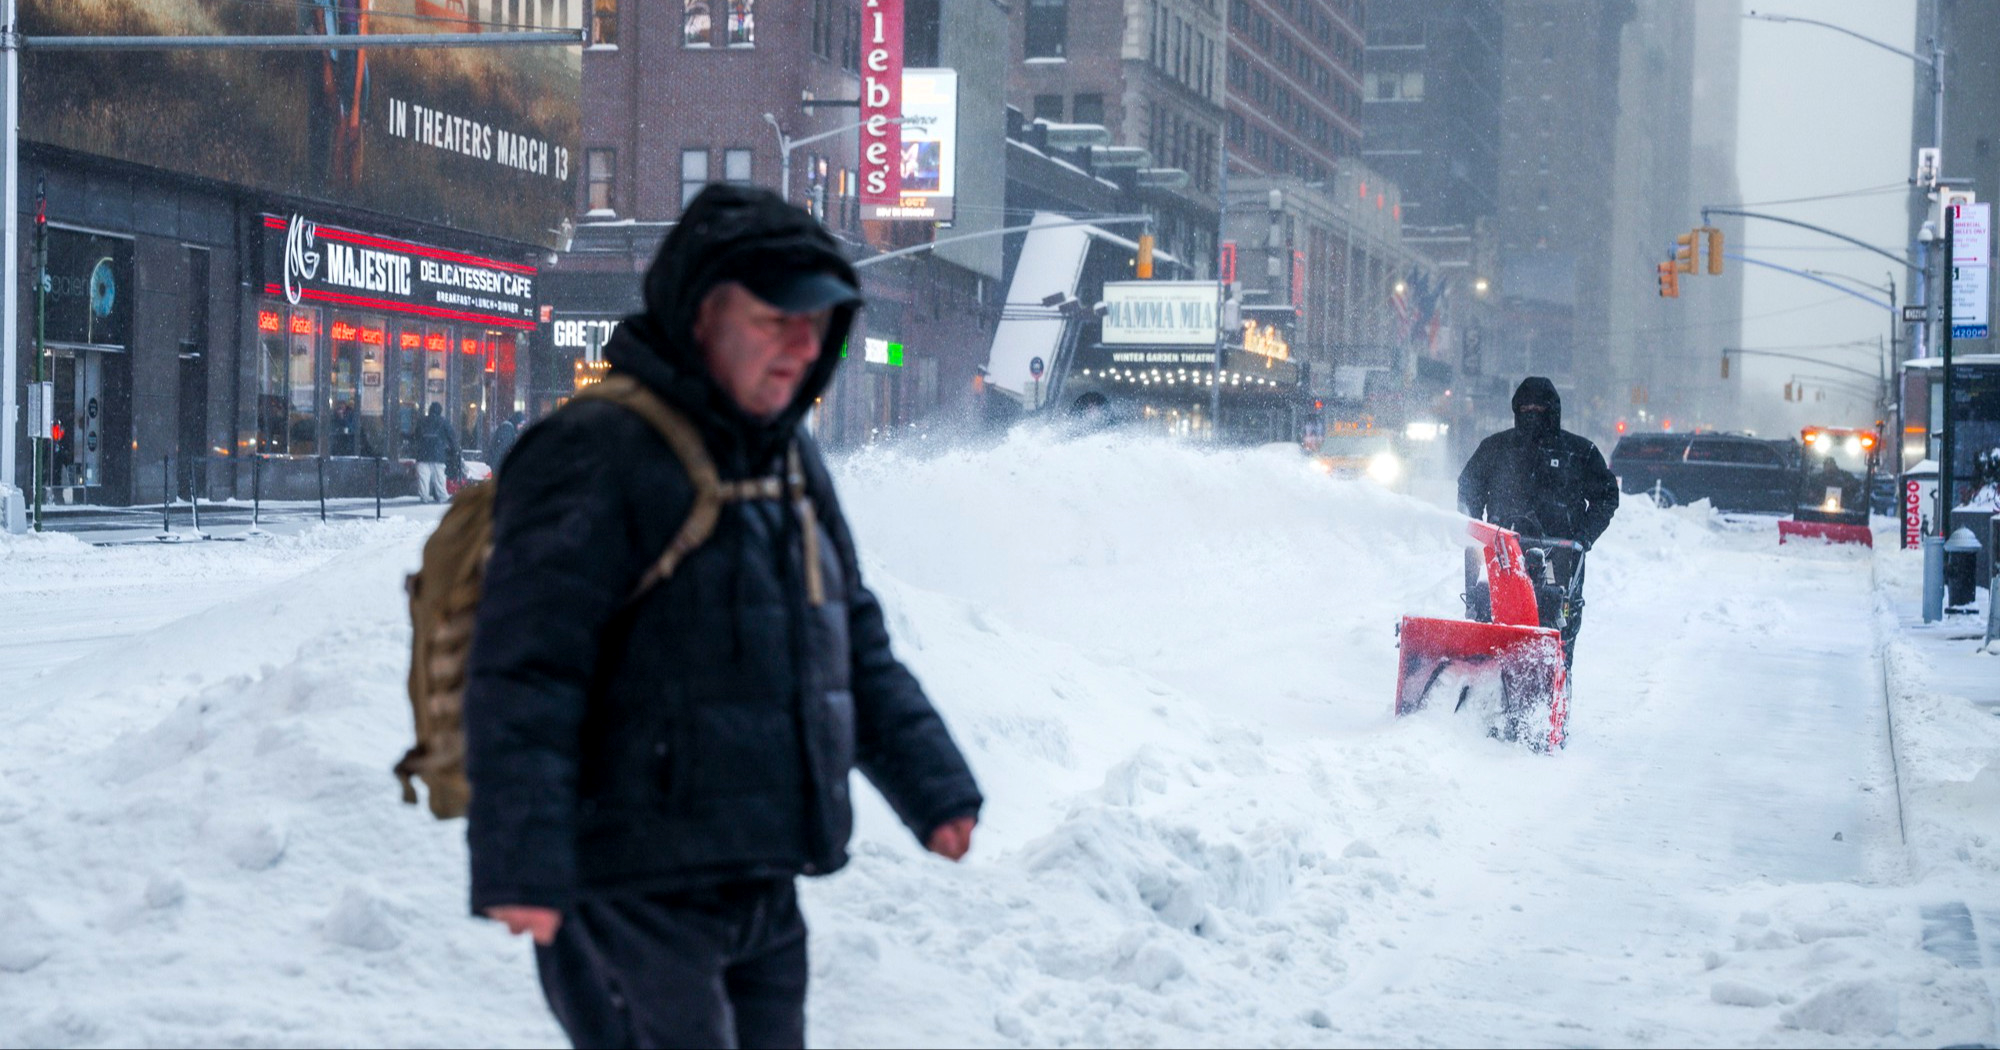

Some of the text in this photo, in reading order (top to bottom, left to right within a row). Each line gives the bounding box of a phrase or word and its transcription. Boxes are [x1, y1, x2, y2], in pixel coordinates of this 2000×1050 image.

[866, 0, 890, 194] lebee's
[389, 98, 569, 181] IN THEATERS MARCH 13
[327, 243, 411, 296] MAJESTIC
[420, 260, 531, 299] DELICATESSEN CAFE
[436, 291, 471, 306] BREAKFAST
[475, 298, 494, 310] LUNCH
[497, 300, 519, 313] DINNER
[1106, 301, 1174, 329] MAMMA
[259, 311, 279, 331] Salads
[291, 315, 312, 335] Pastas
[1113, 353, 1216, 363] WINTER GARDEN THEATRE
[1907, 480, 1920, 550] HICAGO
